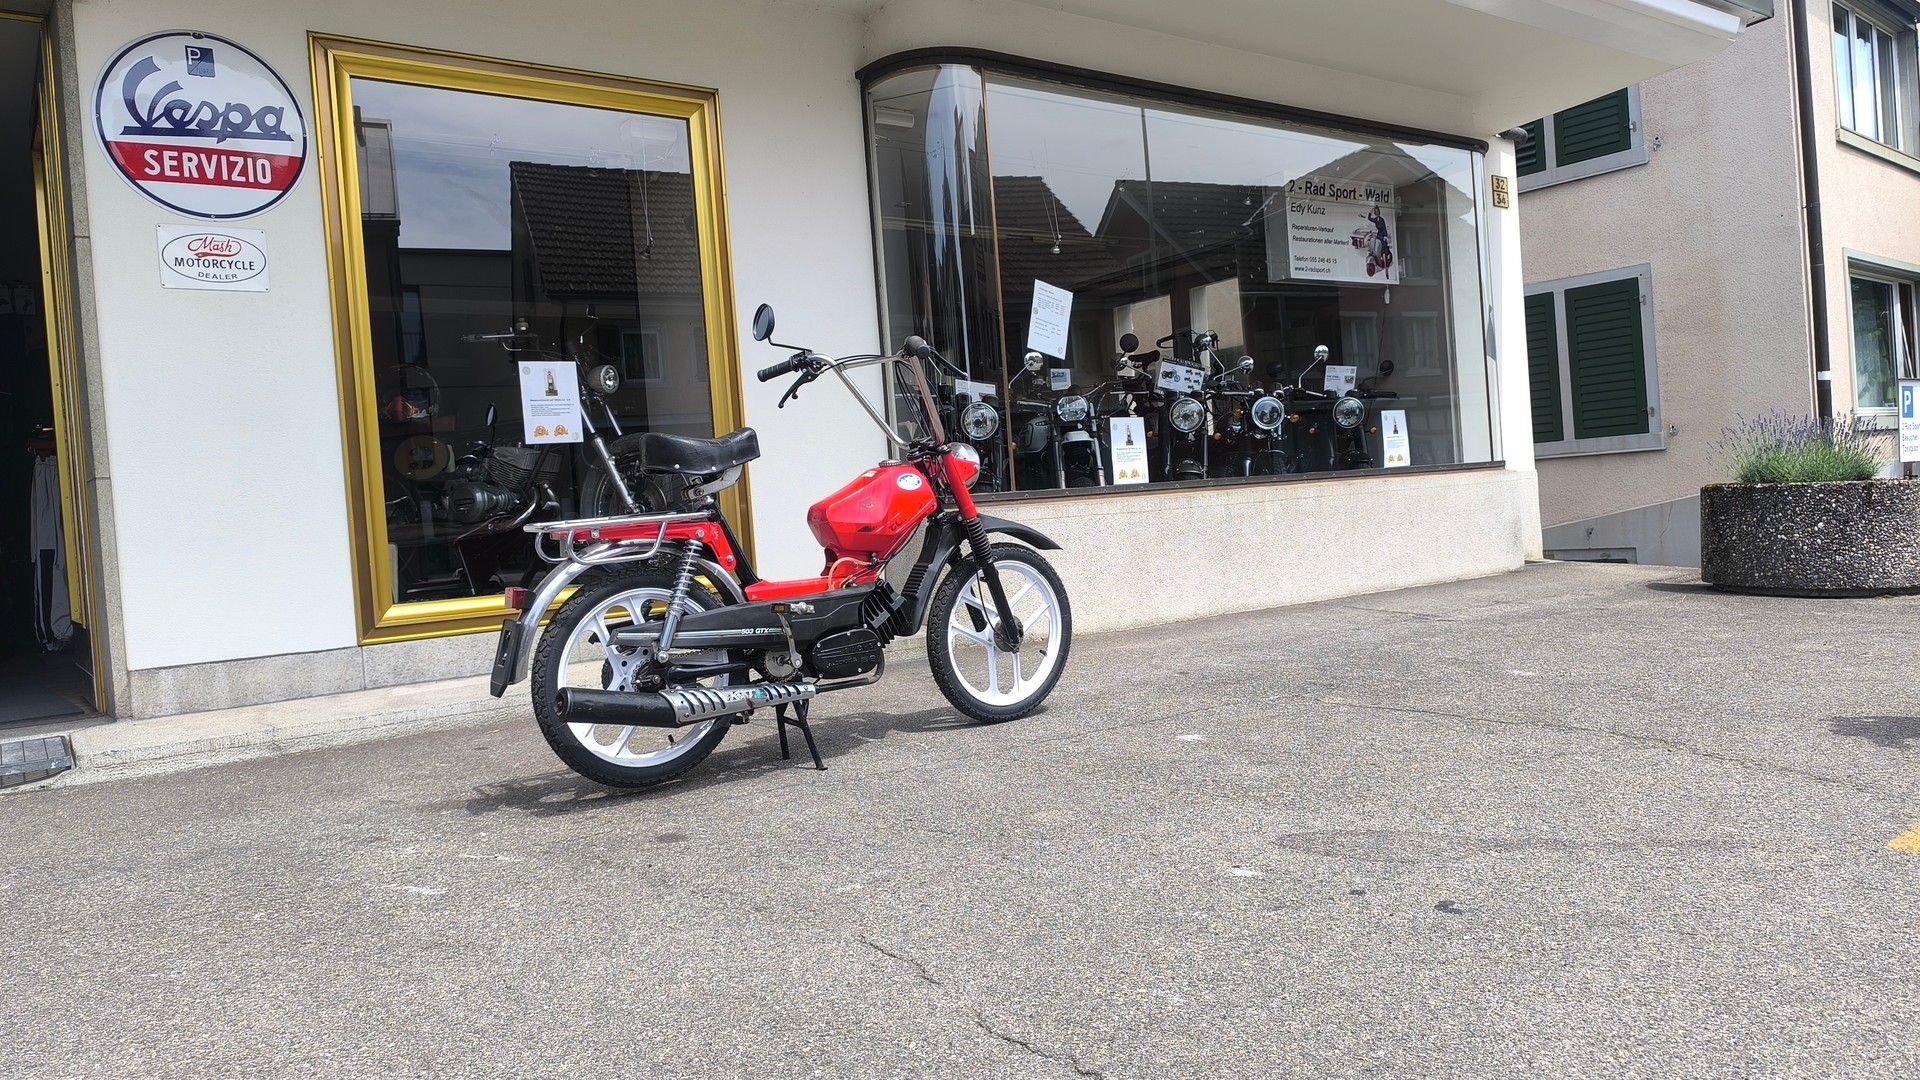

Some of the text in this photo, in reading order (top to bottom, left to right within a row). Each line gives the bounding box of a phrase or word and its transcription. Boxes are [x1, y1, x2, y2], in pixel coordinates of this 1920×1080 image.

[186, 47, 201, 65] P
[120, 55, 294, 144] Vespa
[143, 148, 272, 184] SERVIZIO
[1289, 179, 1296, 193] 2
[1305, 181, 1325, 196] Rad
[1328, 183, 1357, 200] Sport
[1365, 188, 1390, 203] Wald
[1495, 177, 1505, 190] 32
[1496, 193, 1507, 206] 34
[1290, 202, 1326, 216] Edy Kunz
[187, 236, 242, 255] Mash
[174, 257, 256, 271] MOTORCYCLE
[197, 271, 239, 280] DEALER
[1903, 390, 1912, 414] P
